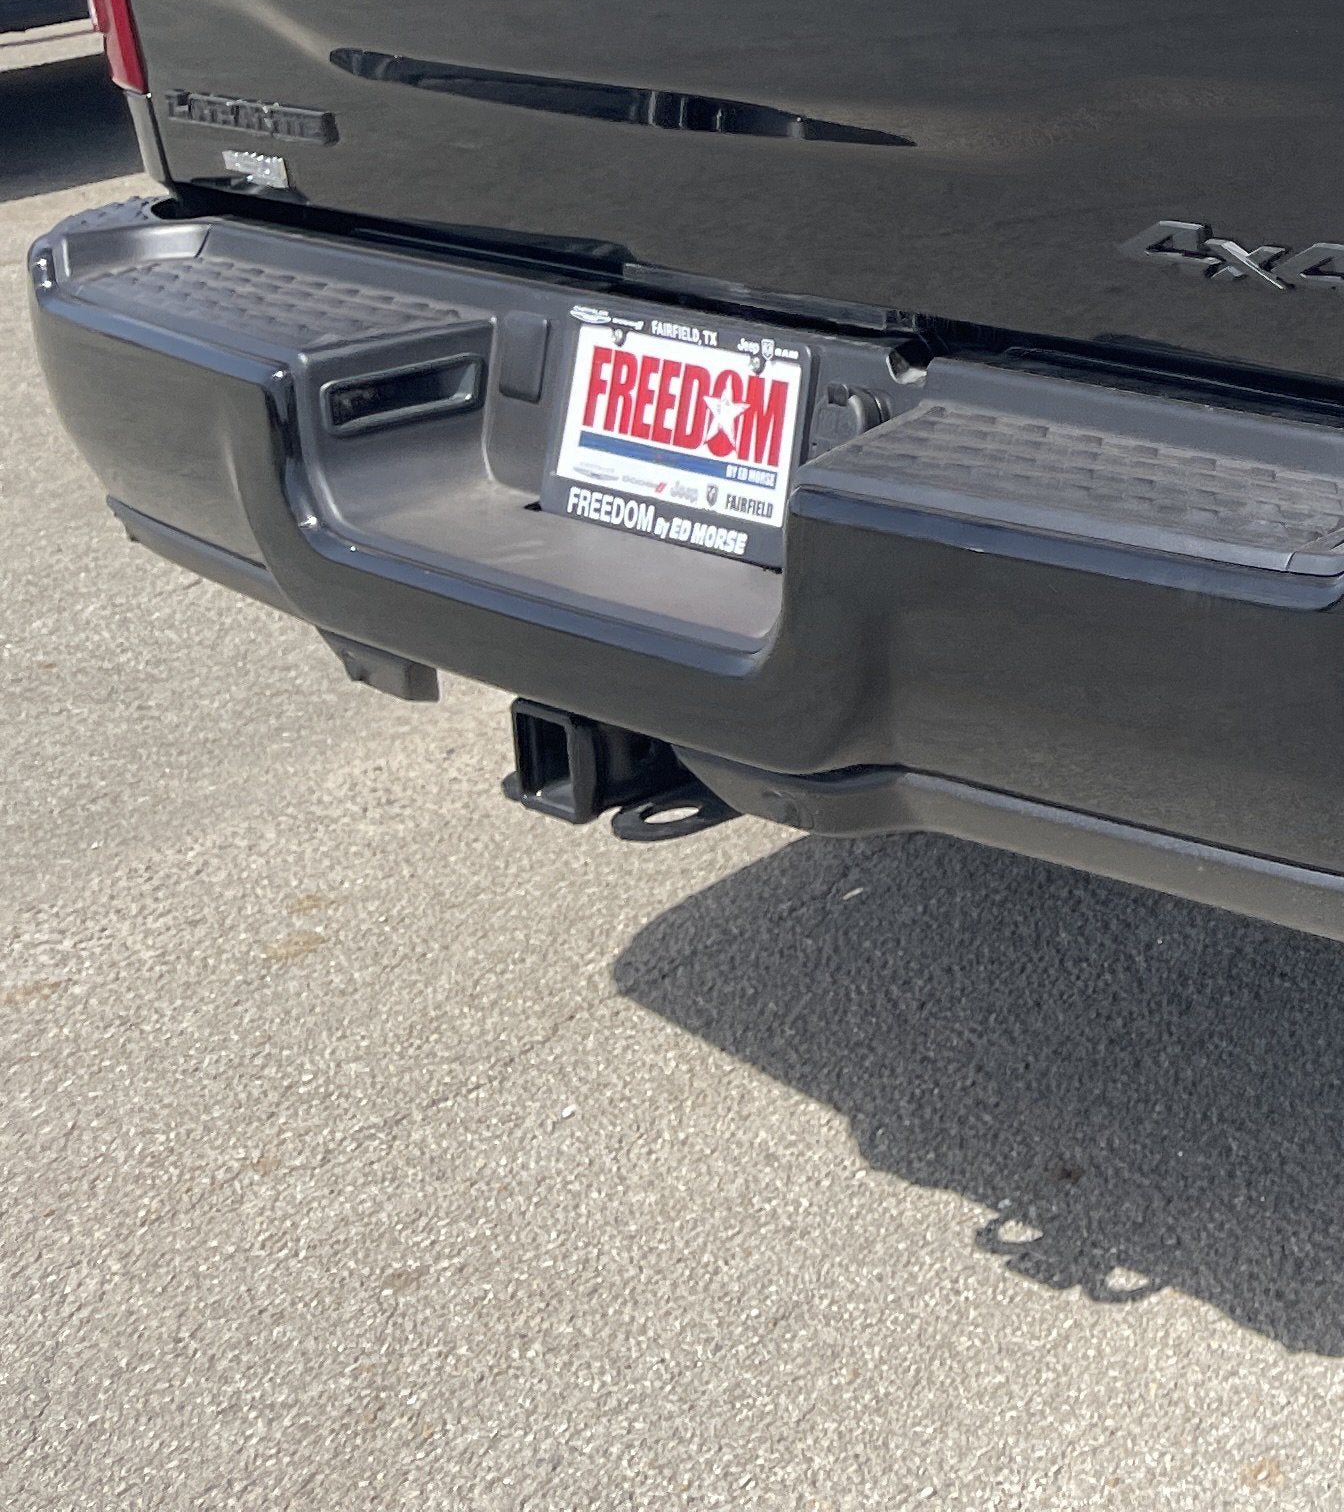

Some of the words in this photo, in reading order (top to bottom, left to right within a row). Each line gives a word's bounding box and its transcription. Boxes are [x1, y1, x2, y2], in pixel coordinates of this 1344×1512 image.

[702, 330, 717, 346] TX
[582, 345, 790, 467] FREEDOM
[748, 469, 776, 486] MORSE
[725, 494, 774, 518] FAIRFIELD
[567, 487, 655, 532] FREEDOM
[669, 517, 692, 541] ED
[690, 522, 748, 555] MORSE
